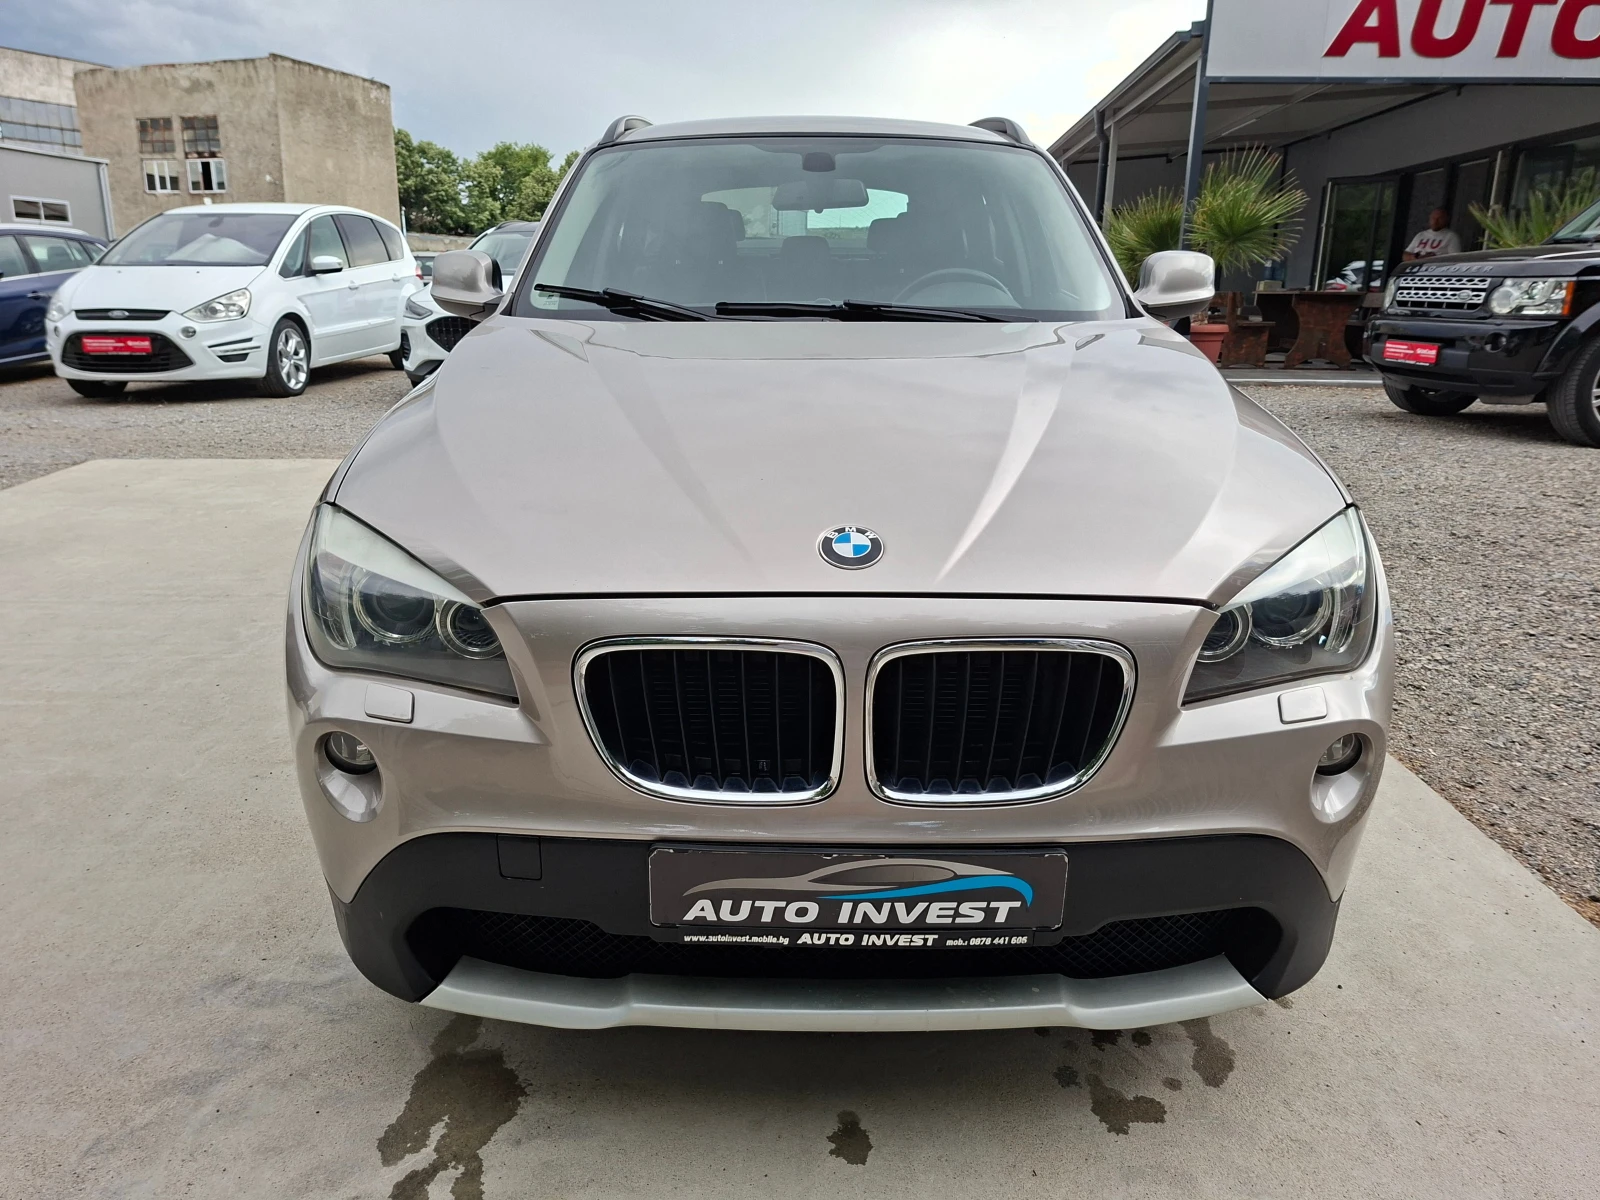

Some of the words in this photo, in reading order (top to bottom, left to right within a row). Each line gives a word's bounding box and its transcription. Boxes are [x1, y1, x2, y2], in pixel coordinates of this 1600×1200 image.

[1323, 0, 1600, 58] AUTO
[1416, 238, 1442, 249] HU
[1441, 265, 1494, 273] ROVER
[826, 526, 877, 539] BMW
[683, 899, 819, 924] AUTO
[837, 900, 1022, 924] INVEST
[683, 934, 790, 945] www.autoinvest.mobile.bg
[796, 932, 855, 945] AUTO
[861, 933, 939, 946] INVEST
[992, 936, 1009, 945] 441
